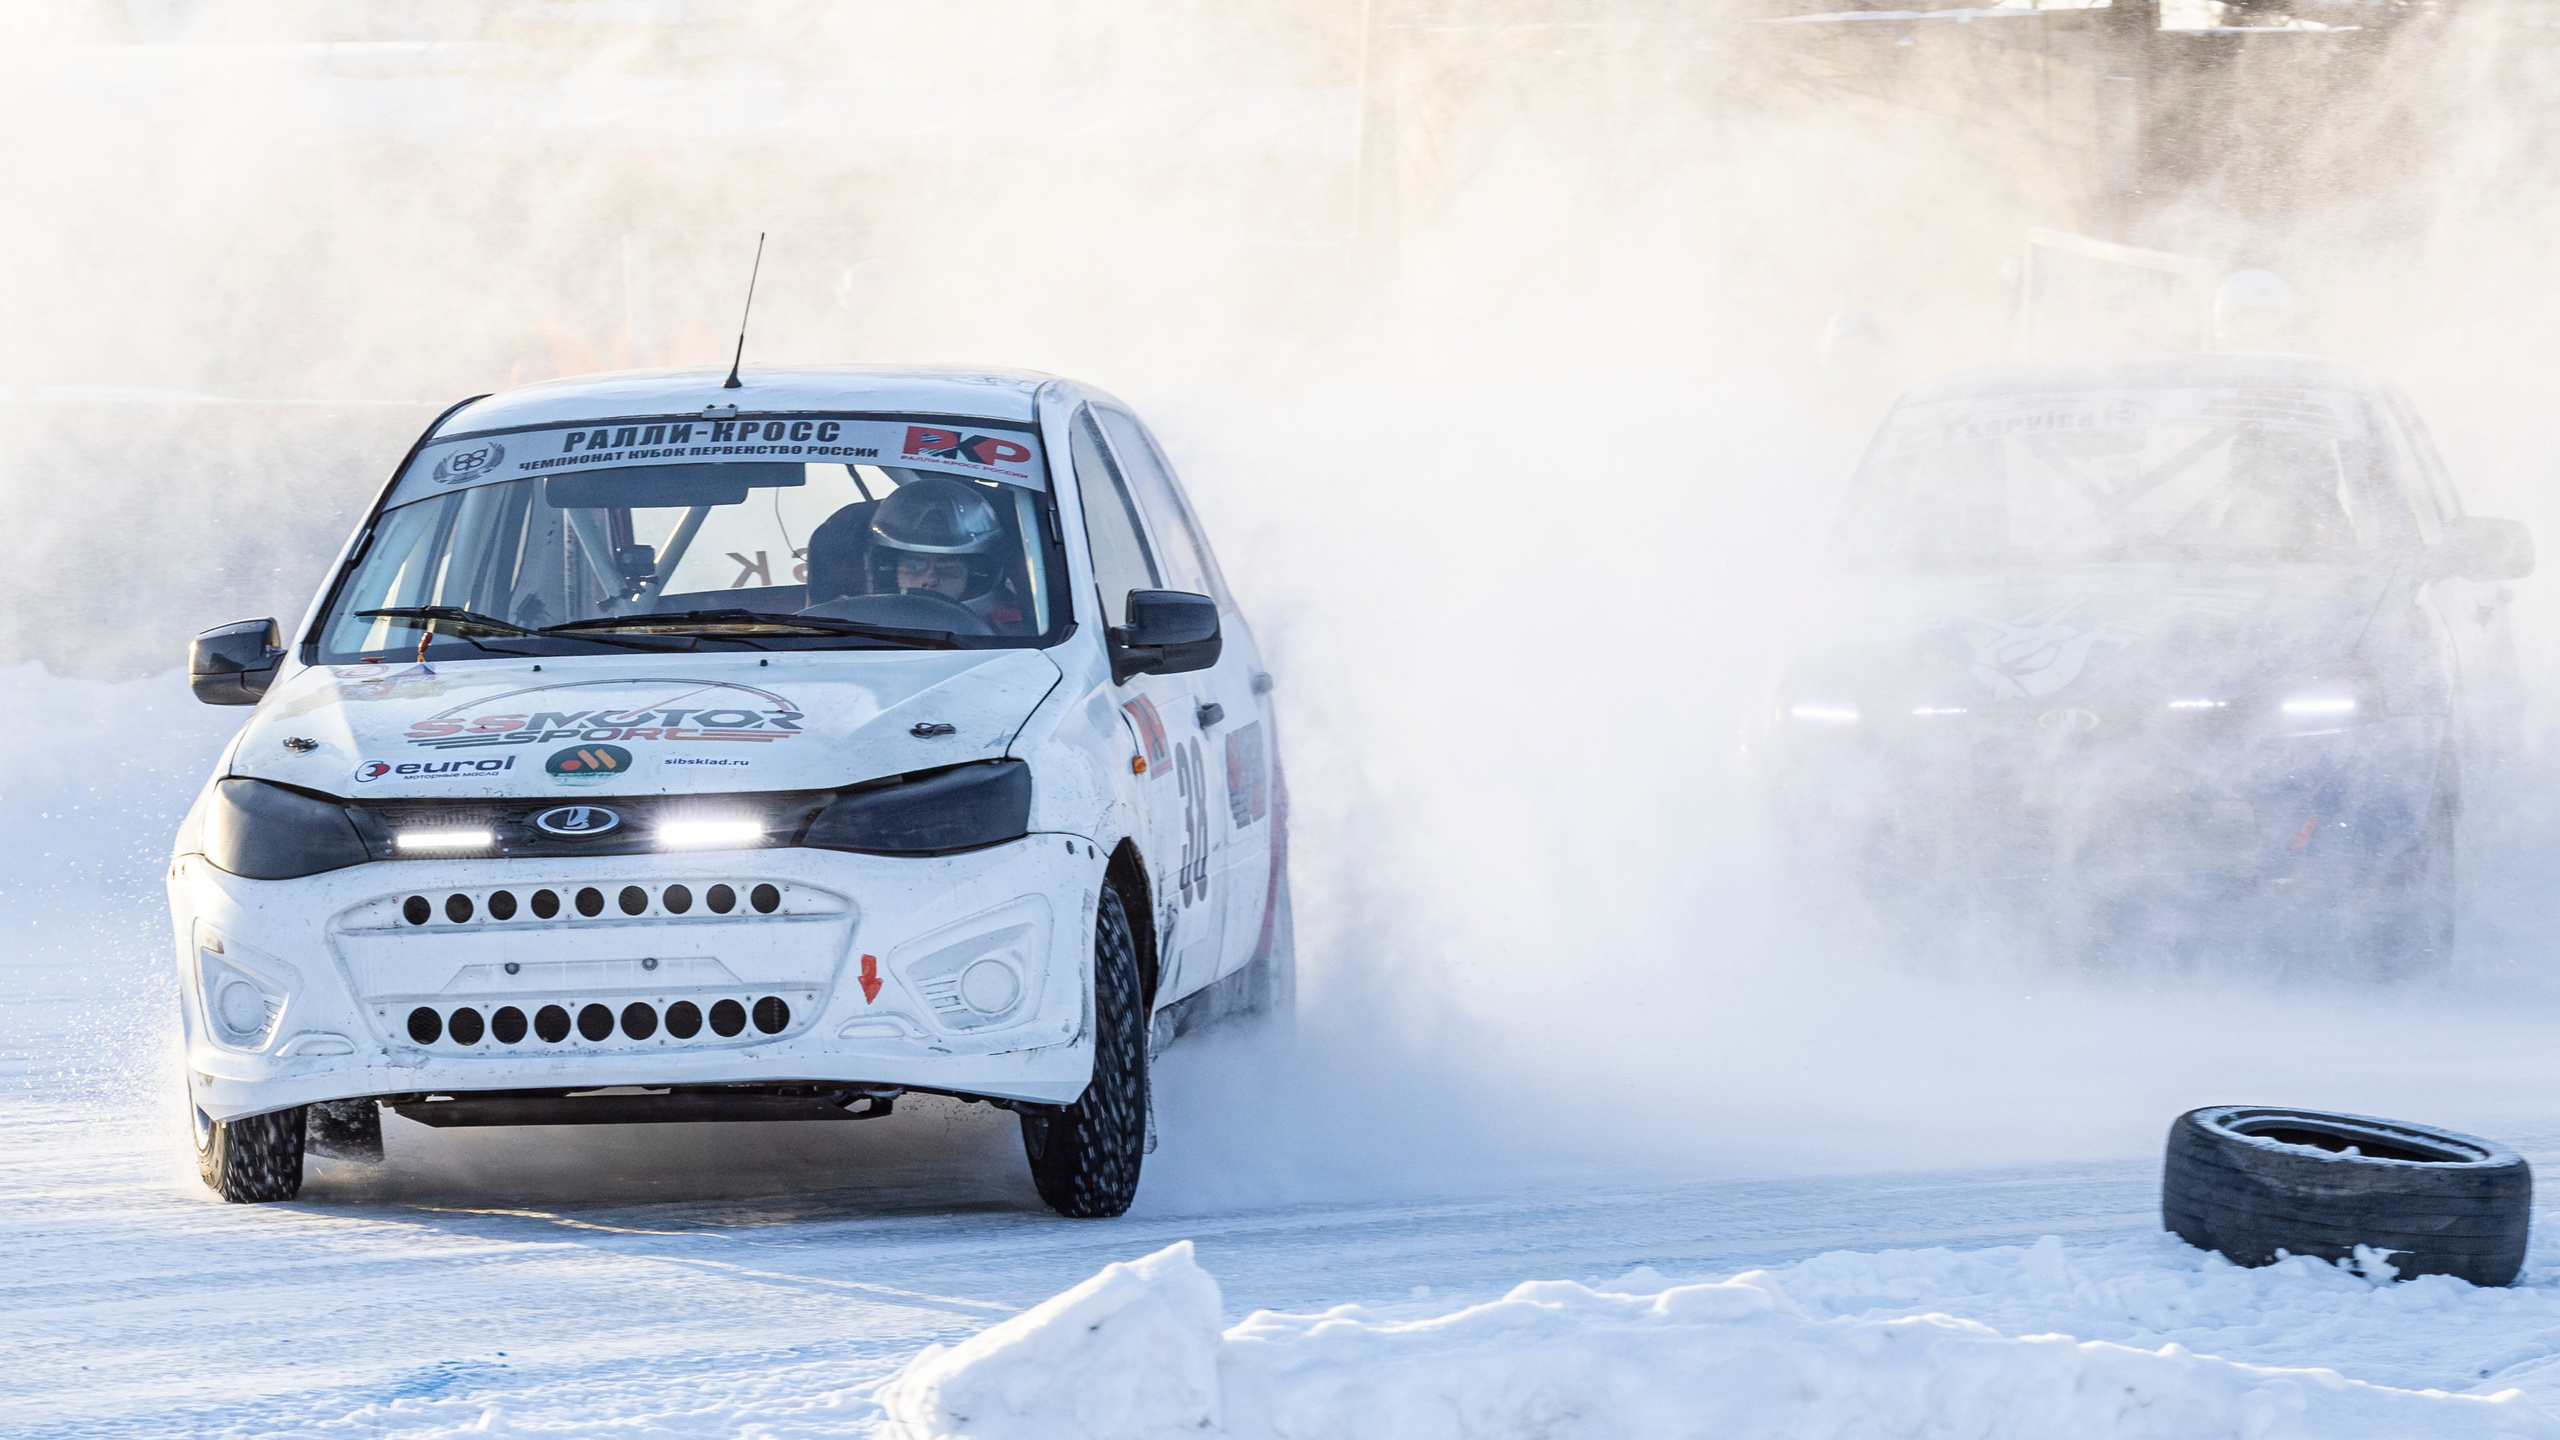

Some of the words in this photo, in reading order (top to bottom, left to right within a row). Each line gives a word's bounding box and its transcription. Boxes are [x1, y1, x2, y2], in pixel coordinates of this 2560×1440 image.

[562, 421, 841, 453] РАЛЛИ-КРОСС
[519, 451, 624, 471] ЧЕМПИОНАТ
[628, 447, 686, 460] КУБОК
[689, 445, 805, 456] ПЕРВЕНСТВО
[806, 446, 880, 458] РОССИИ
[900, 455, 980, 470] РАЛЛИ-КРОСС
[403, 709, 804, 738] SSMOTOR
[395, 755, 517, 775] eurol
[664, 757, 749, 766] sibsklad.ru
[1175, 736, 1208, 909] 38
